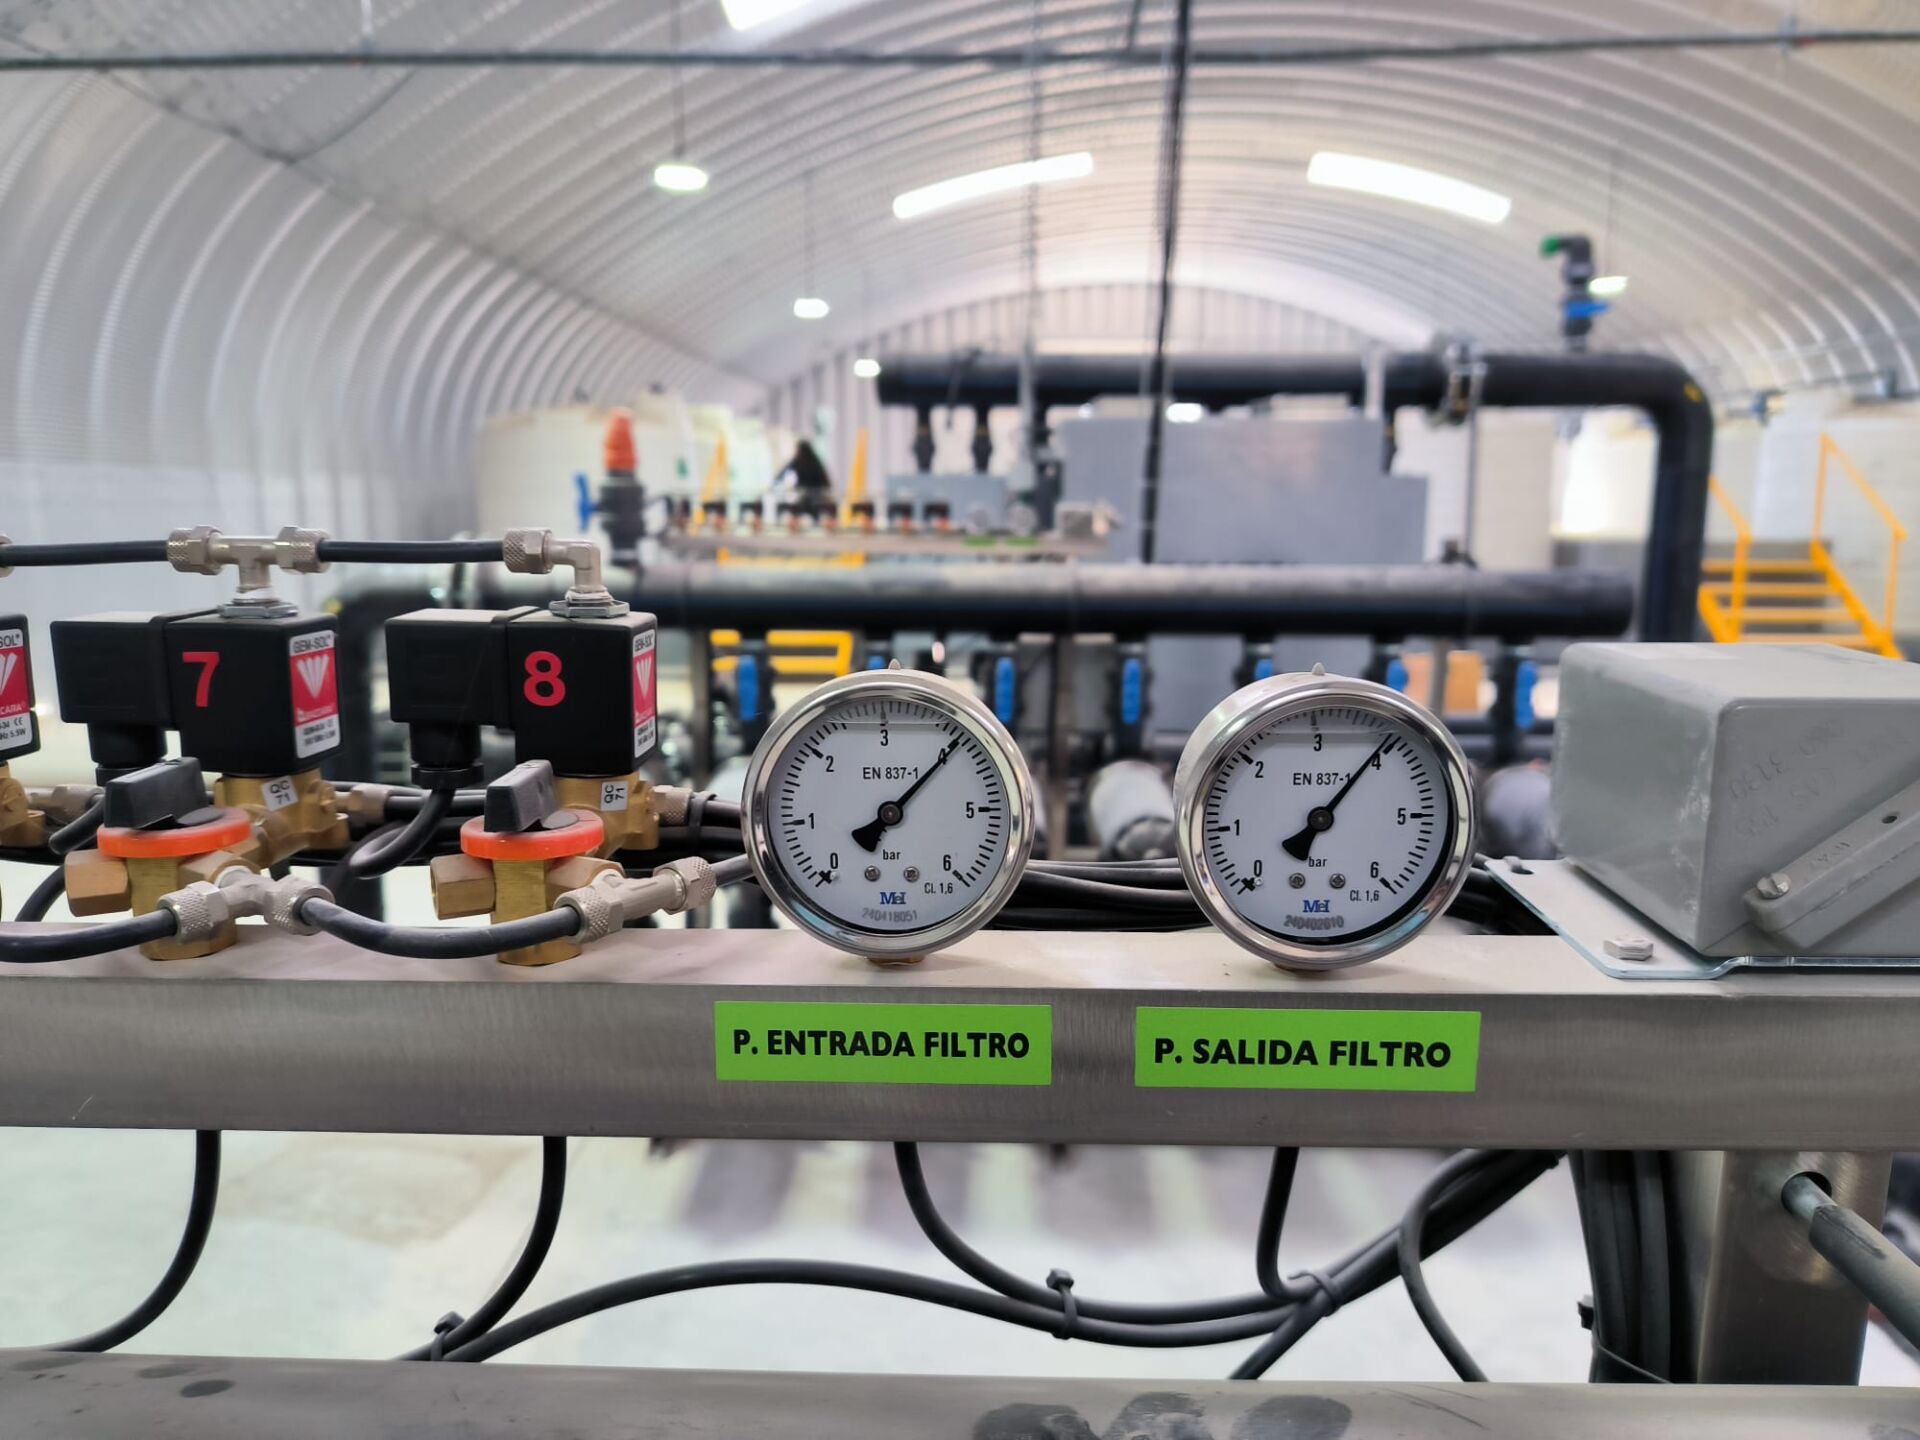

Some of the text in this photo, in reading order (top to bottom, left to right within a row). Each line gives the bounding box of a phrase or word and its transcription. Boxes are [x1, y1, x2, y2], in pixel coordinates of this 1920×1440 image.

[182, 651, 220, 708] 7
[522, 650, 567, 707] 8
[879, 730, 890, 747] 3
[1313, 734, 1323, 752] 3
[825, 756, 835, 773] 2
[1255, 761, 1264, 779] 2
[1371, 752, 1382, 771] 4
[863, 767, 919, 780] EN 837-1
[1293, 773, 1312, 786] EN
[270, 779, 291, 794] QC
[603, 784, 614, 804] QC
[965, 801, 975, 818] 5
[1397, 808, 1406, 826] 5
[809, 813, 815, 829] 1
[1233, 819, 1241, 836] 1
[829, 852, 839, 870] 0
[882, 848, 902, 861] bar
[942, 855, 952, 871] 6
[1308, 856, 1328, 868] bar
[1253, 859, 1263, 878] 0
[1370, 861, 1379, 878] 6
[939, 882, 954, 895] 1,6
[1365, 890, 1380, 903] 1,6
[733, 1029, 1030, 1058] P. ENTRADA FILTRO
[1154, 1037, 1451, 1068] P. SALIDA FILTRO
